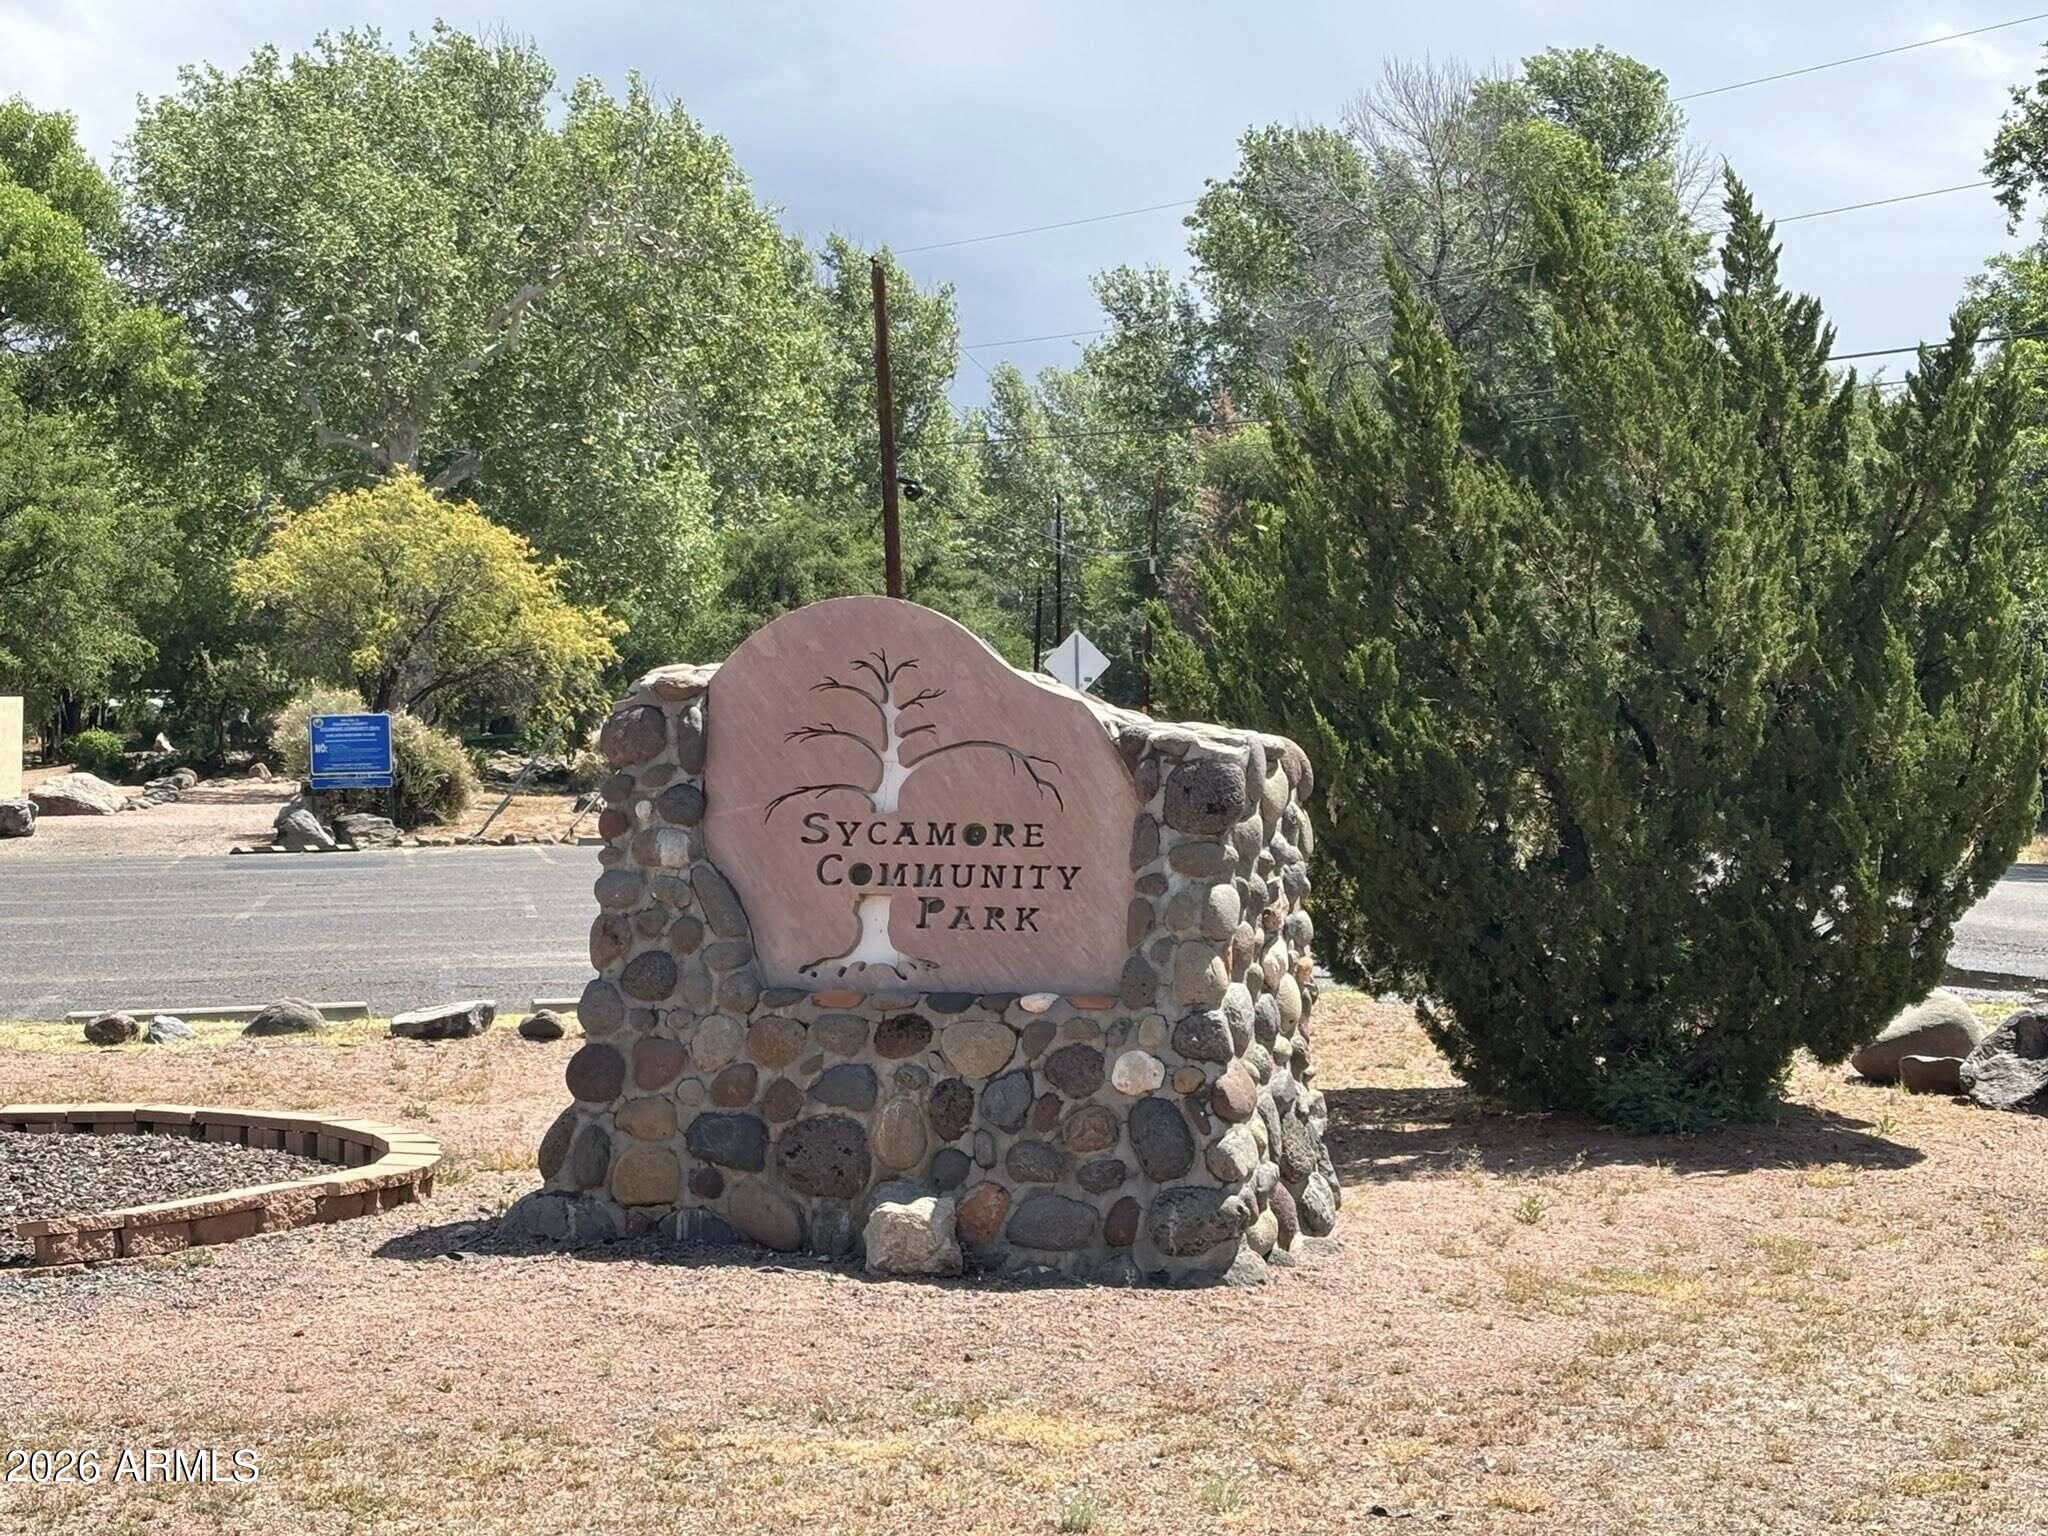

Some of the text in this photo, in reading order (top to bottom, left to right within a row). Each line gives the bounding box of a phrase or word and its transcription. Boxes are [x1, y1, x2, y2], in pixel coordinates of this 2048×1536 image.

[800, 812, 1045, 848] SYCAMORE
[816, 853, 1082, 890] COMMUNITY
[915, 896, 1041, 932] PARK
